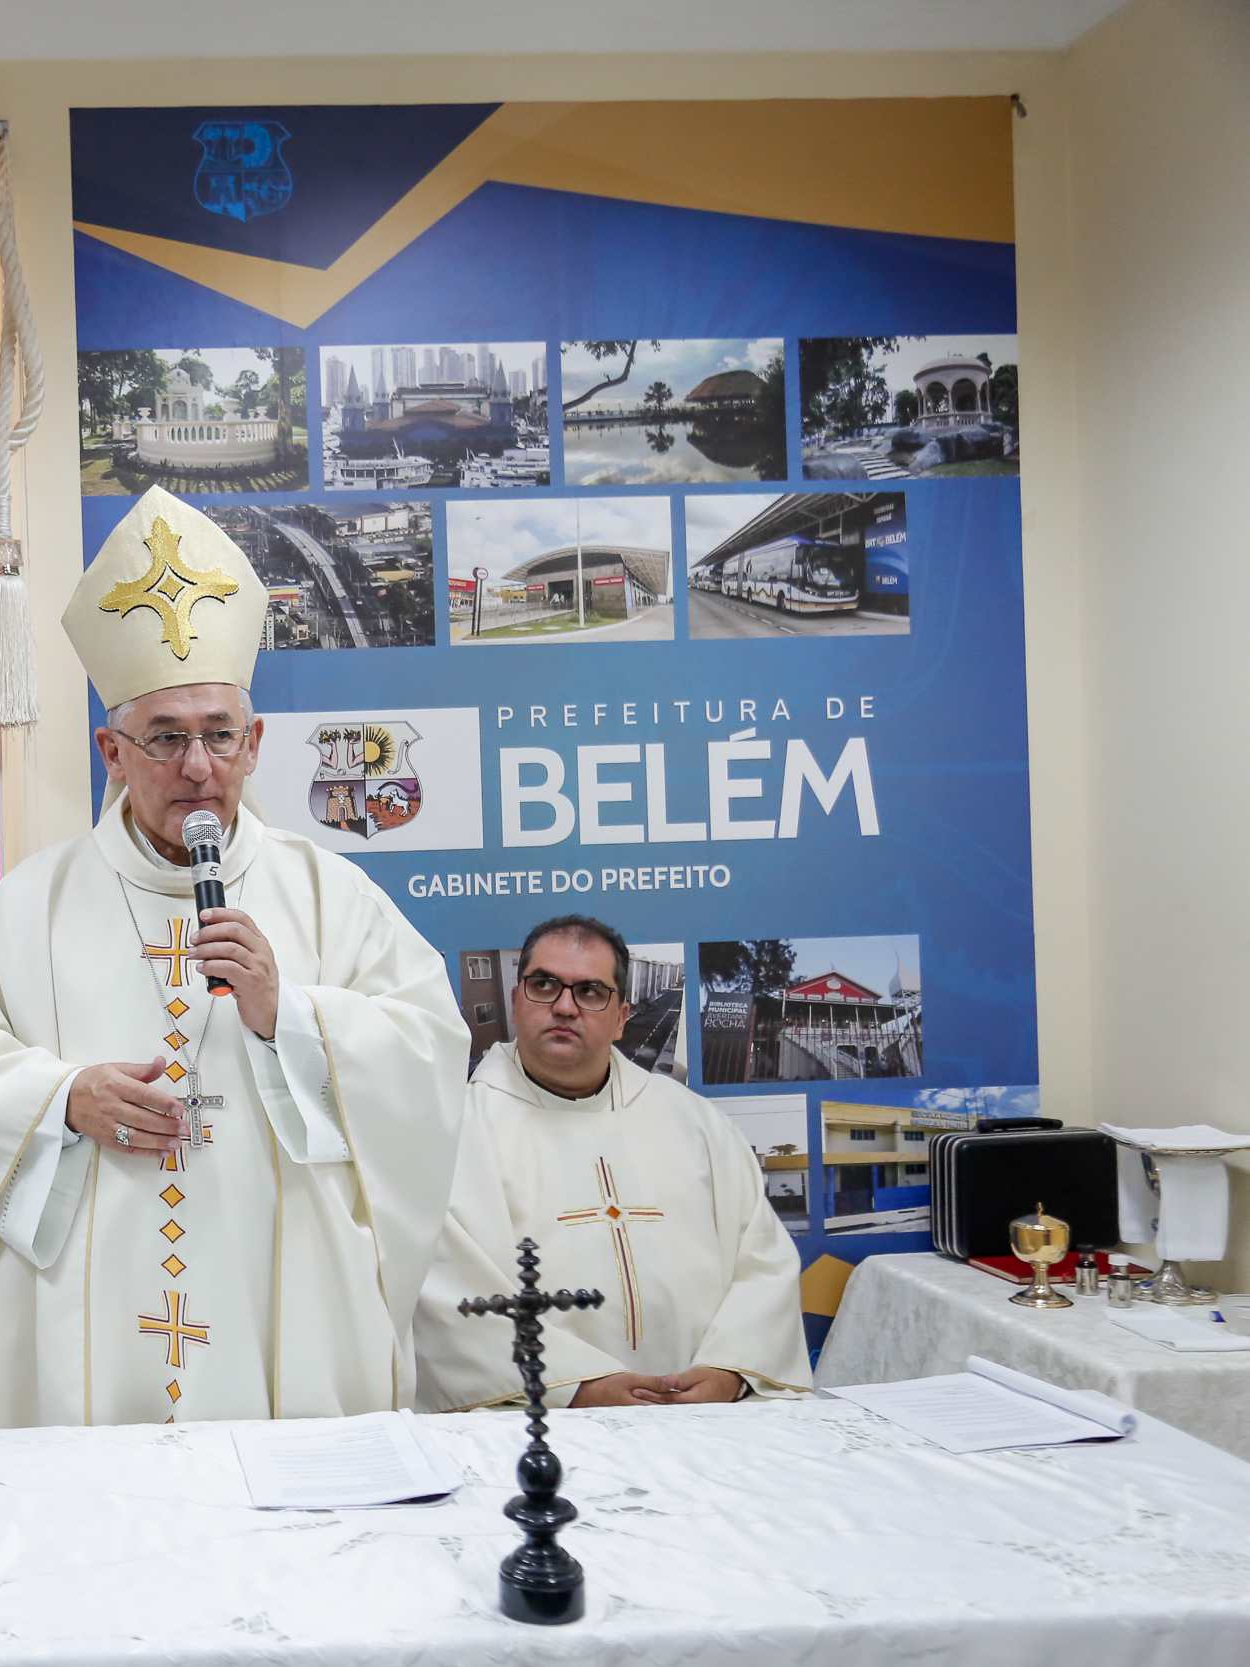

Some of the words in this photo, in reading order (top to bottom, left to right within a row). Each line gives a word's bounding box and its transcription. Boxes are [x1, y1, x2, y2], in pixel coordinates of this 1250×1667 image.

[885, 531, 907, 546] BELÉM
[497, 698, 791, 729] PREFEITURA
[826, 696, 874, 720] DE
[499, 726, 880, 848] BELÉM
[408, 871, 544, 898] GABINETE
[551, 869, 594, 893] DO
[601, 865, 731, 892] PREFEITO
[704, 1018, 745, 1028] ROCHA
